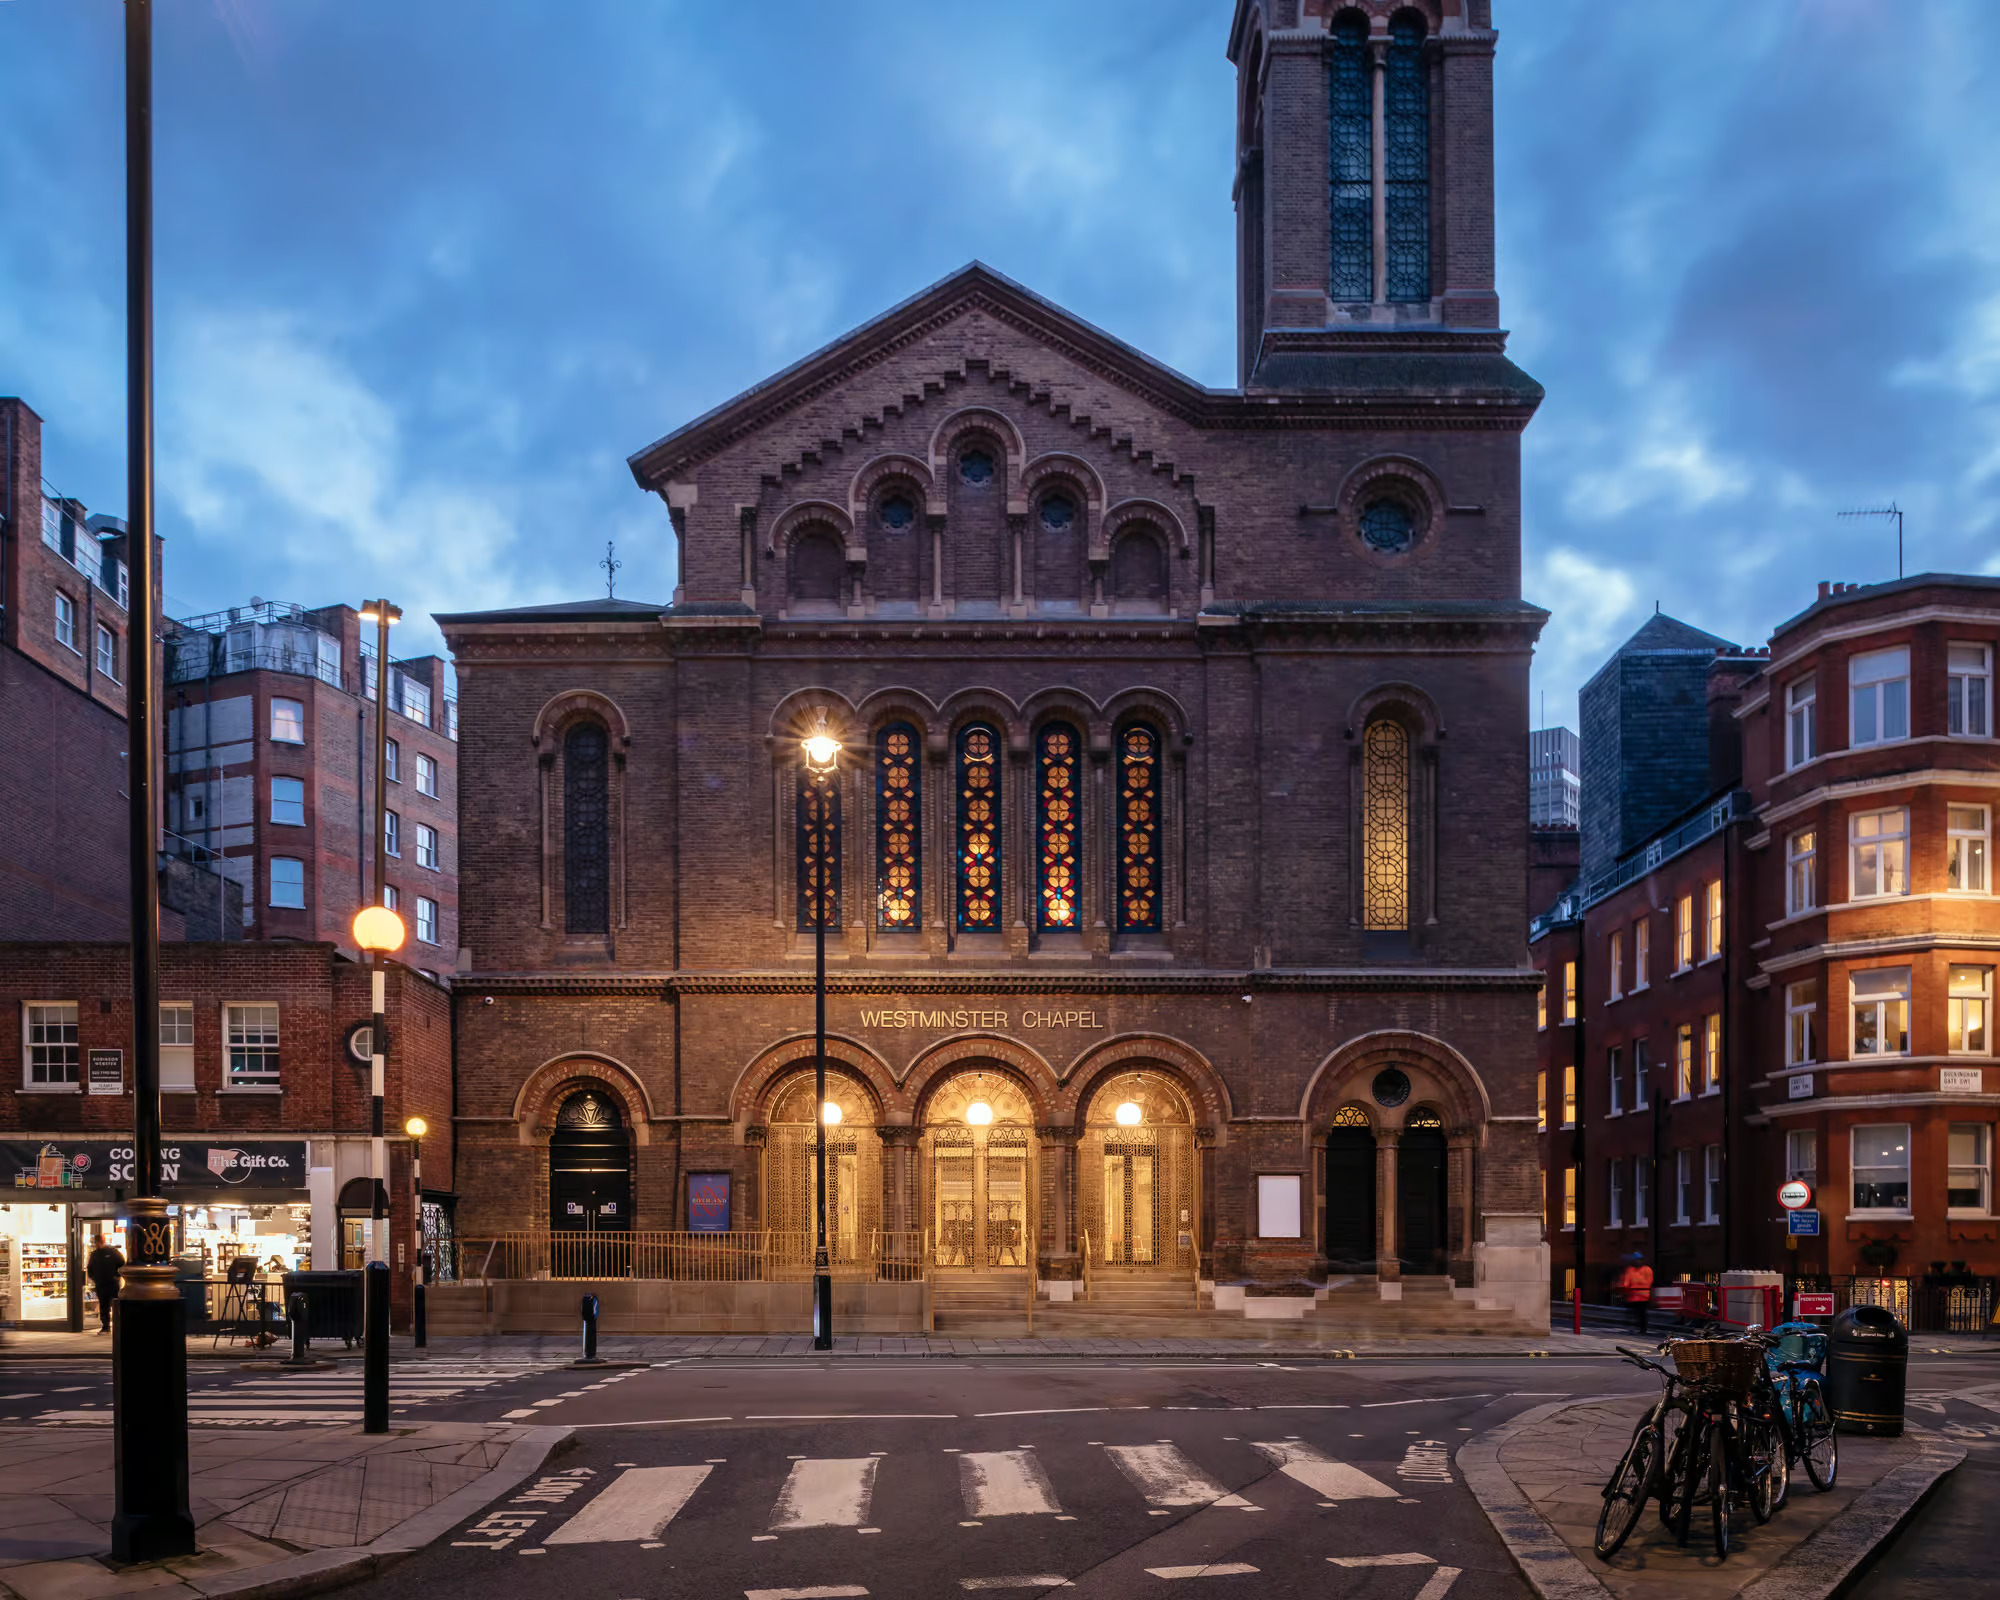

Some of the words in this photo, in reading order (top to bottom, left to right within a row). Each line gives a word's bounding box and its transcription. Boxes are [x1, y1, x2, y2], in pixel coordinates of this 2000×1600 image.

[860, 1010, 1008, 1028] WESTMINSTER
[1022, 1010, 1104, 1028] CHAPEL
[109, 1148, 181, 1160] CONG
[210, 1155, 238, 1168] The
[239, 1155, 266, 1168] Gift
[267, 1155, 290, 1168] Co.
[109, 1163, 181, 1181] SON
[507, 1476, 592, 1504] LOOK
[450, 1510, 549, 1550] LEFT
